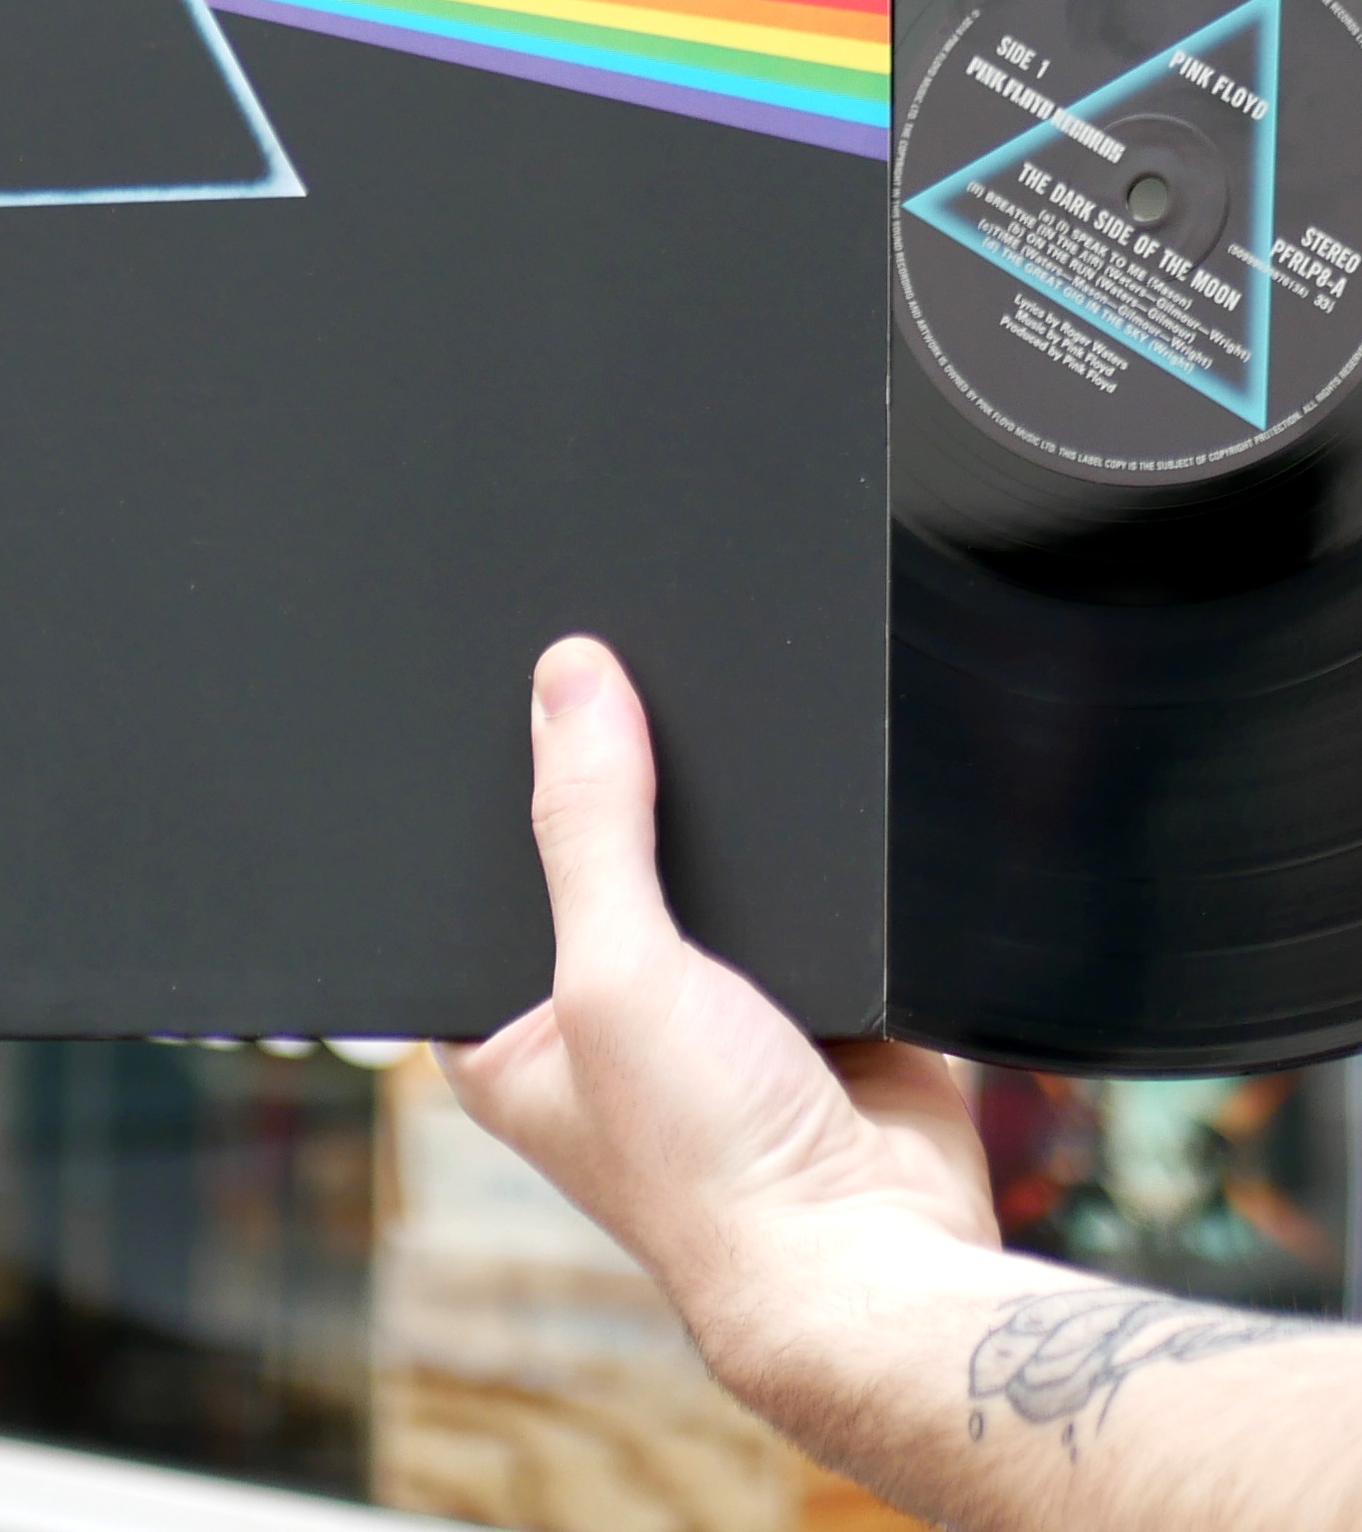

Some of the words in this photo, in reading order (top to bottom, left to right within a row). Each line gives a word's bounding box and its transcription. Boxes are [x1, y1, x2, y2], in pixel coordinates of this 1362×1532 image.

[1328, 1, 1360, 36] RECORDS
[994, 33, 1037, 71] SIDE
[1033, 58, 1050, 80] 1
[1166, 47, 1216, 89] PINK
[1210, 73, 1270, 123] FLOYD
[964, 54, 1010, 93] PINK
[1001, 76, 1056, 121] FLOYD
[1047, 105, 1126, 164] RECORDS
[900, 121, 913, 139] THE
[891, 188, 901, 197] IN
[891, 220, 903, 251] SOUND
[983, 190, 1037, 229] BREATHE
[1034, 222, 1057, 242] (IN
[1054, 233, 1080, 255] THE
[1077, 248, 1105, 272] AIR)
[1015, 161, 1053, 196] THE
[1048, 182, 1096, 222] DARK
[1091, 208, 1135, 246] SIDE
[1131, 233, 1160, 262] OF
[1155, 248, 1193, 282] THE
[1189, 268, 1242, 312] MOON
[1024, 231, 1046, 250] ON
[1044, 243, 1069, 265] THE
[1067, 258, 1096, 281] RUN
[1298, 224, 1362, 275] STEREO
[894, 251, 915, 300] RECORDING
[1069, 228, 1109, 258] SPEAK
[1107, 251, 1127, 269] TO
[1126, 263, 1147, 281] ME
[1145, 274, 1194, 311] (Mason)
[1267, 237, 1349, 299] PFRLP8-A
[907, 299, 923, 319] AND
[1000, 247, 1025, 268] THE
[1023, 261, 1063, 291] GREAT
[1061, 284, 1086, 306] GIG
[1084, 298, 1101, 314] IN
[1099, 308, 1125, 329] THE
[1123, 322, 1149, 344] SKY
[915, 317, 943, 358] ARTWORK
[1011, 292, 1047, 321] Lyrics
[1043, 311, 1062, 330] by
[1058, 321, 1093, 349] Roger
[1089, 339, 1130, 371] Waters
[1013, 309, 1047, 335] Music
[1044, 328, 1063, 346] by
[1059, 337, 1086, 359] Pink
[1082, 352, 1116, 379] Floyd
[937, 354, 949, 366] IS
[998, 314, 1050, 352] Produced
[1045, 344, 1064, 363] by
[1061, 353, 1088, 375] Pink
[1083, 368, 1117, 396] Floyd
[943, 362, 970, 392] OWNED
[1314, 374, 1343, 404] RIGHTS
[965, 387, 979, 401] BY
[975, 396, 994, 415] PINK
[1300, 397, 1319, 415] ALL
[990, 409, 1016, 431] FLOYD
[1013, 424, 1042, 446] MUSIC
[1057, 445, 1077, 460] THIS
[1077, 451, 1103, 466] LABEL
[1103, 457, 1126, 470] COPY
[1127, 460, 1137, 470] IS
[1139, 460, 1154, 470] THE
[1156, 456, 1194, 470] SUBJECT
[1195, 453, 1207, 466] OF
[1207, 438, 1254, 463] COPYRIGHT
